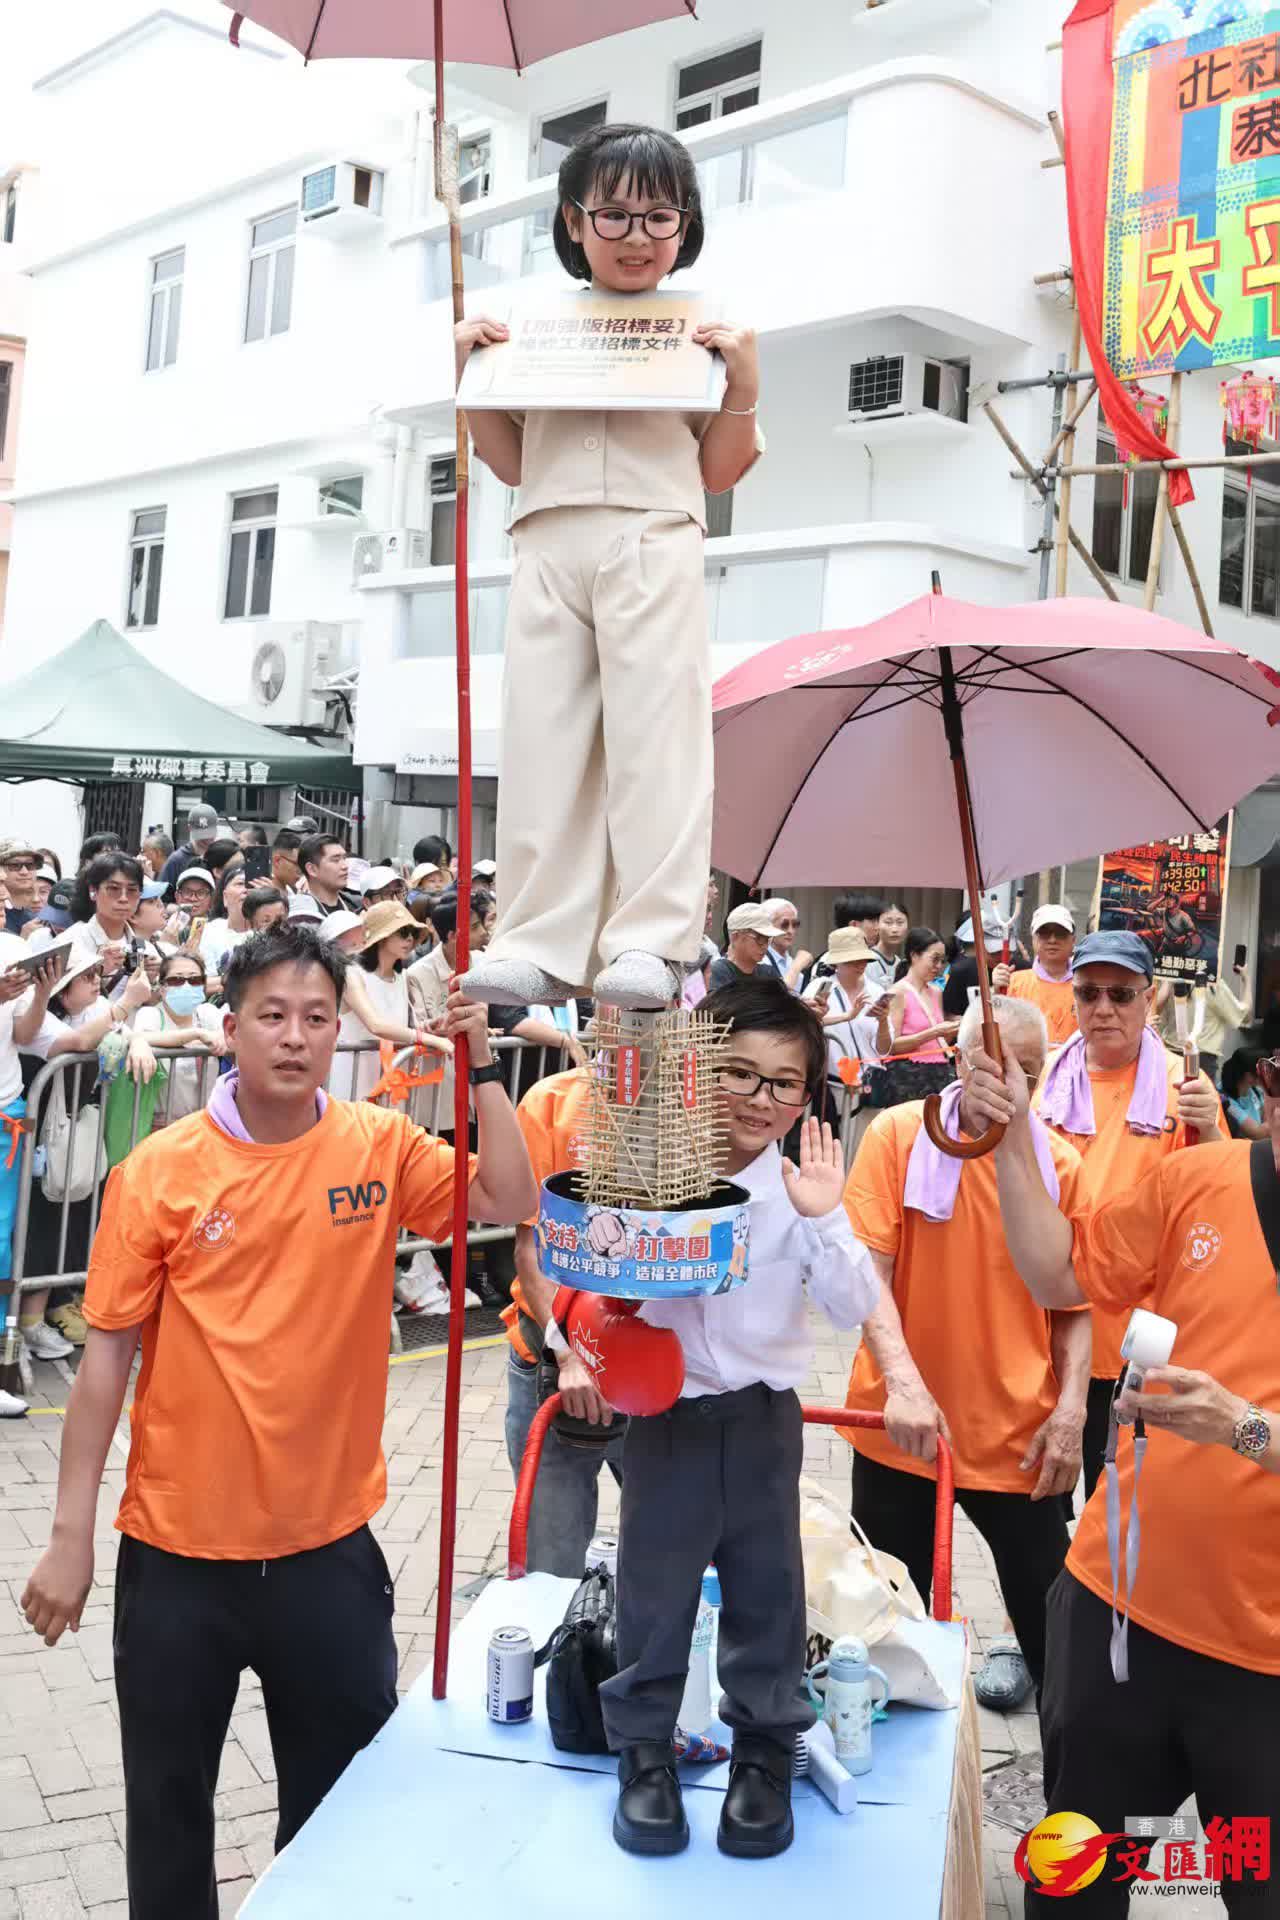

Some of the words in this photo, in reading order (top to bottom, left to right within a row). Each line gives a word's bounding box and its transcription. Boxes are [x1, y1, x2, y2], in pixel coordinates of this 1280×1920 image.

[111, 757, 270, 784] 長洲鄉事委員會
[328, 1180, 387, 1214] FWD
[332, 1212, 376, 1228] insurance
[544, 1217, 579, 1253] 支持
[493, 1655, 502, 1685] GIRL
[491, 1687, 500, 1718] BLUE
